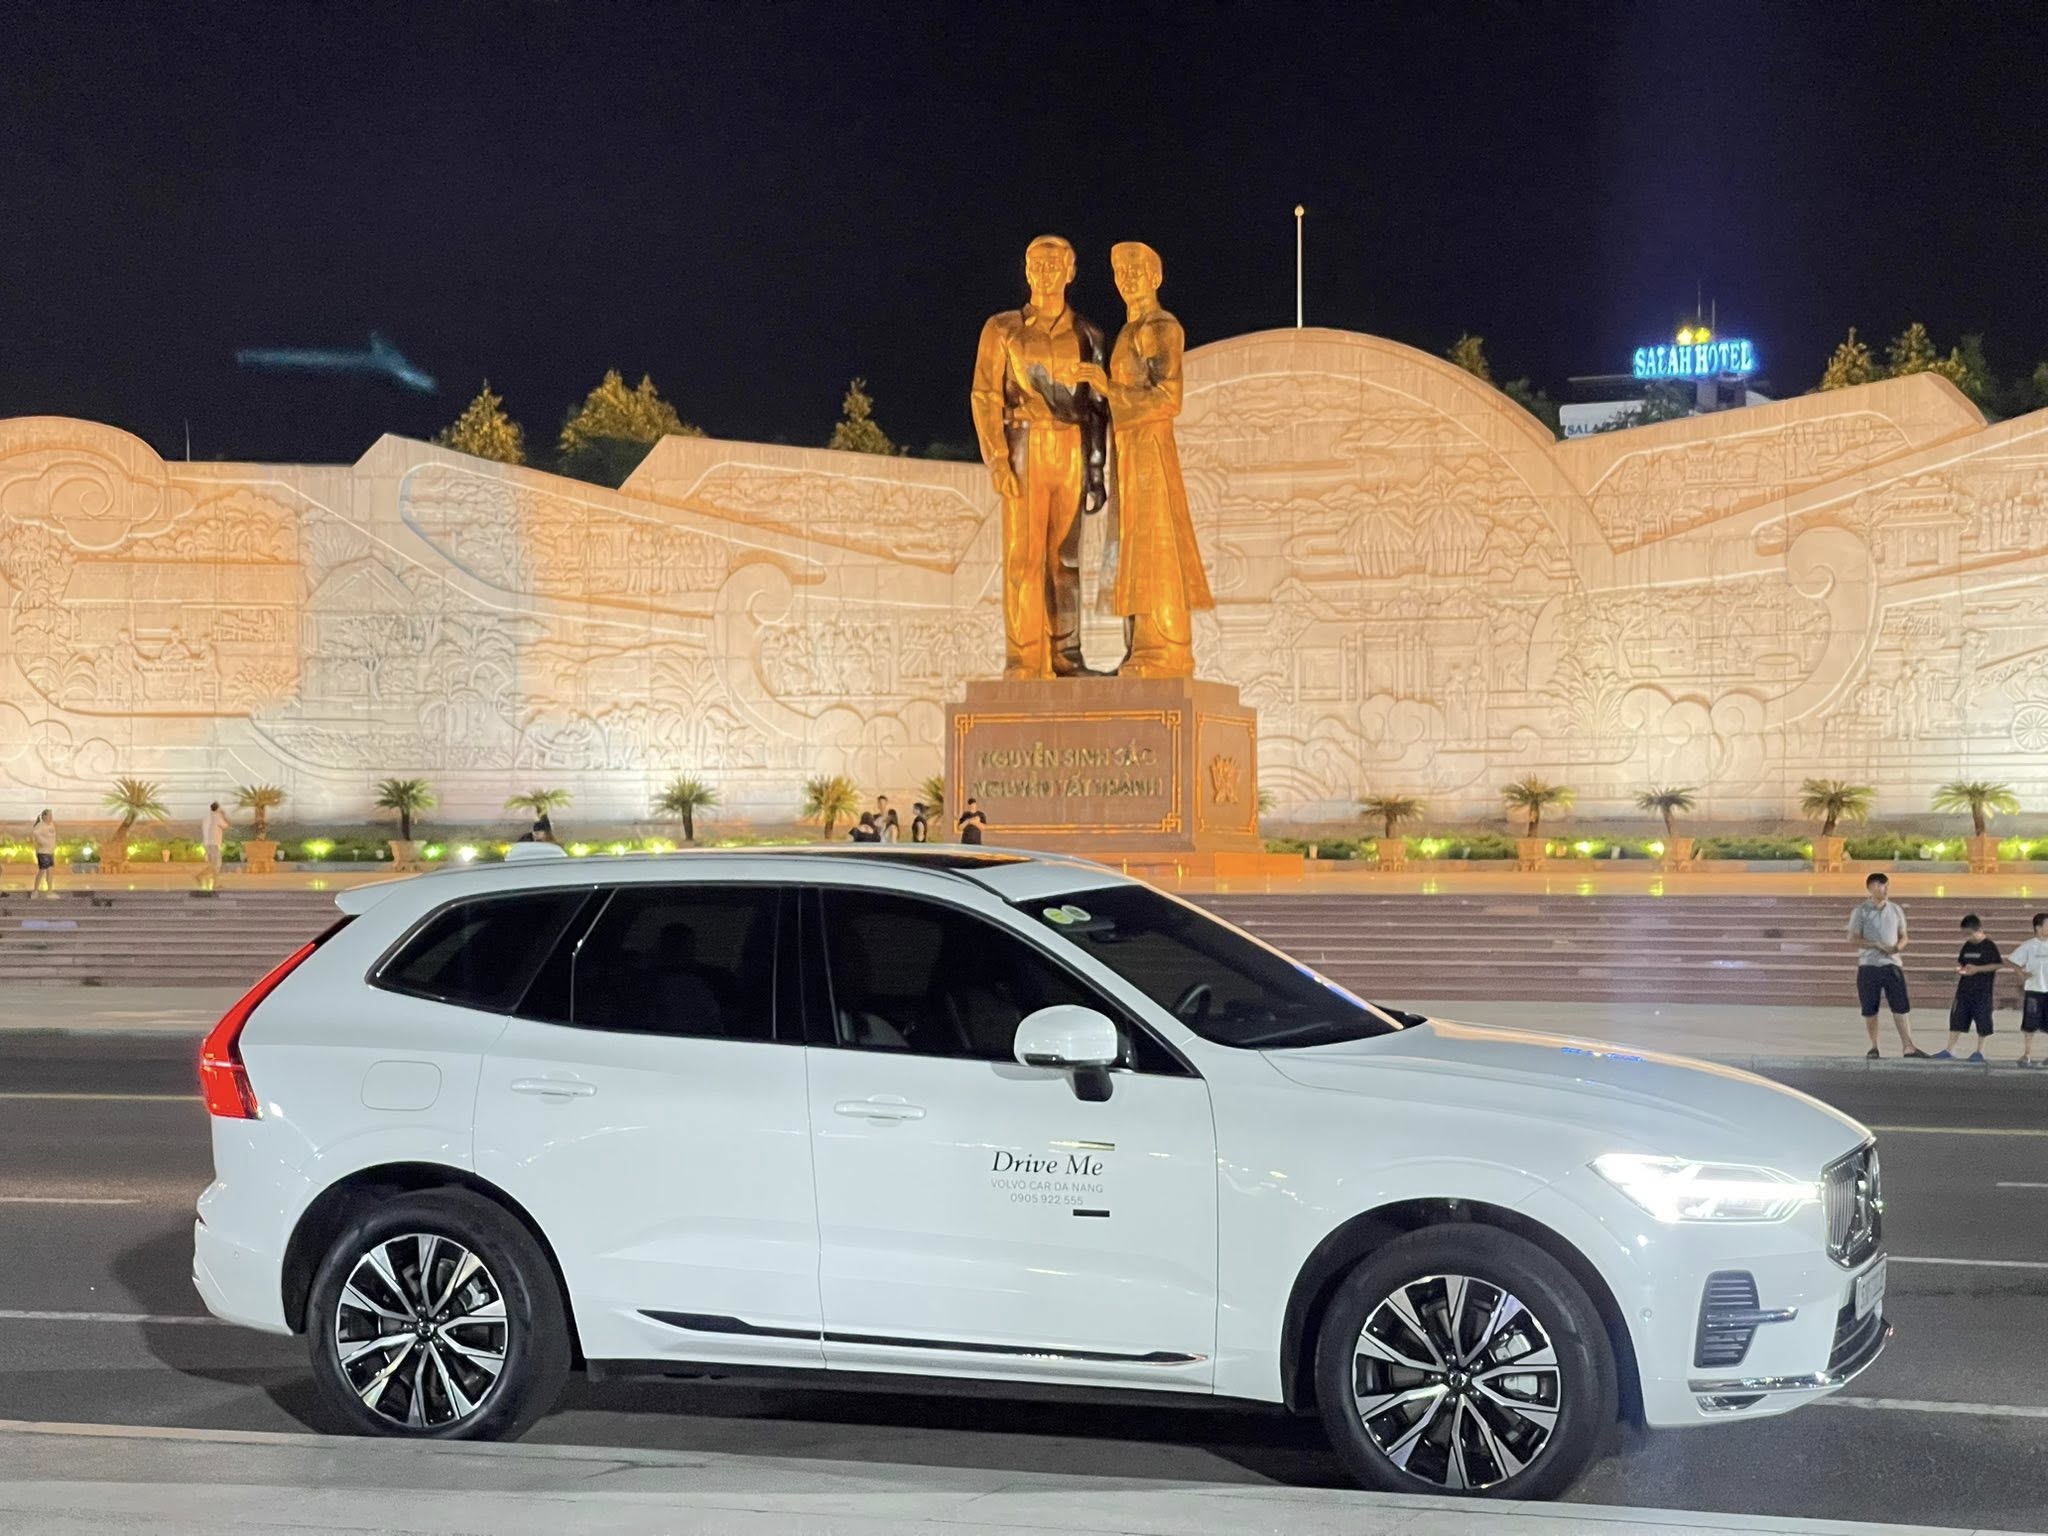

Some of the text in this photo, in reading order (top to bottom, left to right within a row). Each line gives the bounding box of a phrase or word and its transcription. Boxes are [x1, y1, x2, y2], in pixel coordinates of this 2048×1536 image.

[1634, 341, 1751, 376] SALAH HOTEL
[1063, 748, 1109, 767] SINH
[991, 1150, 1104, 1176] Drive Me
[991, 1179, 1104, 1193] VOLVO CAR DA NANG
[1010, 1193, 1084, 1206] 0905 922 555
